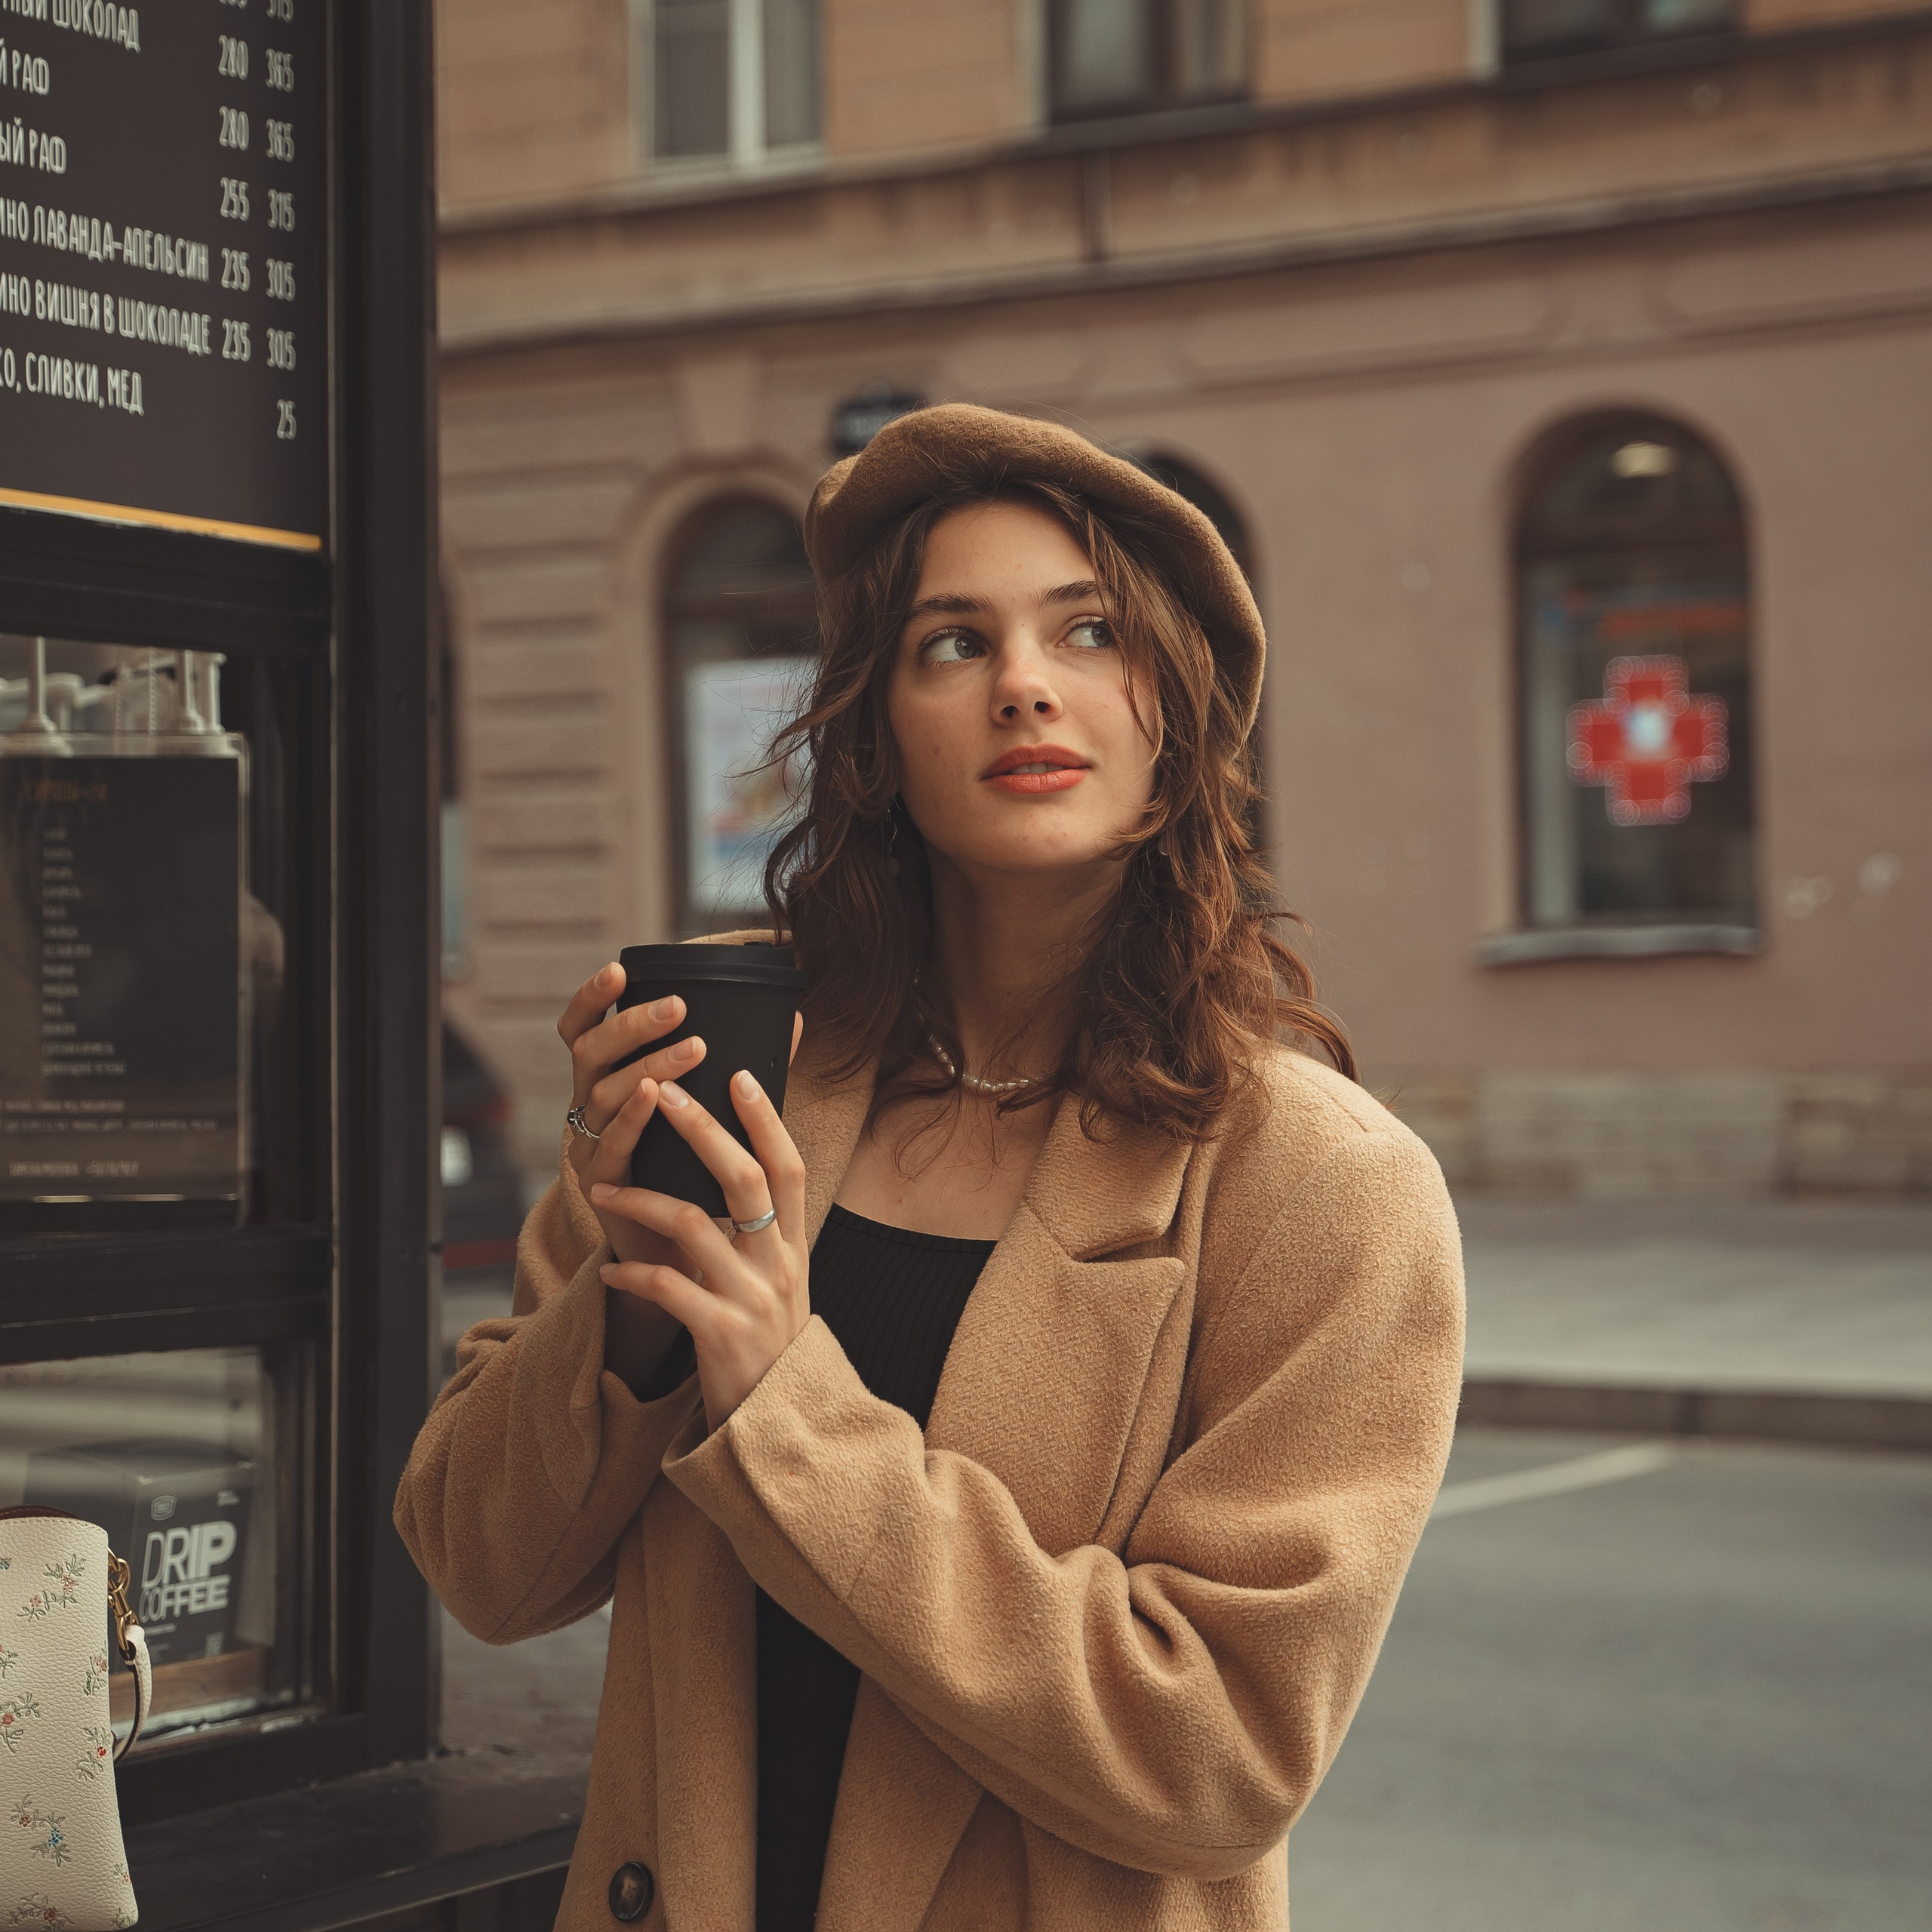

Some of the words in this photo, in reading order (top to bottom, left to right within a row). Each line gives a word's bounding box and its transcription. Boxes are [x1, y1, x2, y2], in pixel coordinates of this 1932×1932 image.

[52, 0, 141, 54] ШОКОЛАД
[12, 49, 51, 96] РАФ
[218, 35, 249, 80] 280
[29, 128, 67, 174] РАФ
[219, 106, 250, 151] 280
[220, 177, 250, 221] 255
[268, 189, 295, 232] 315
[221, 248, 251, 291] 235
[266, 258, 296, 301] 305
[35, 279, 100, 331] ВИШНЯ
[103, 294, 115, 334] В
[118, 296, 213, 356] ШОКОЛАДЕ
[222, 318, 251, 361] 235
[266, 328, 297, 371] 305
[26, 351, 105, 409] СЛИВКИ,
[106, 366, 145, 417] МЕД
[276, 399, 297, 439] 25
[141, 1520, 238, 1589] DRIP
[138, 1574, 232, 1623] COFFEE
